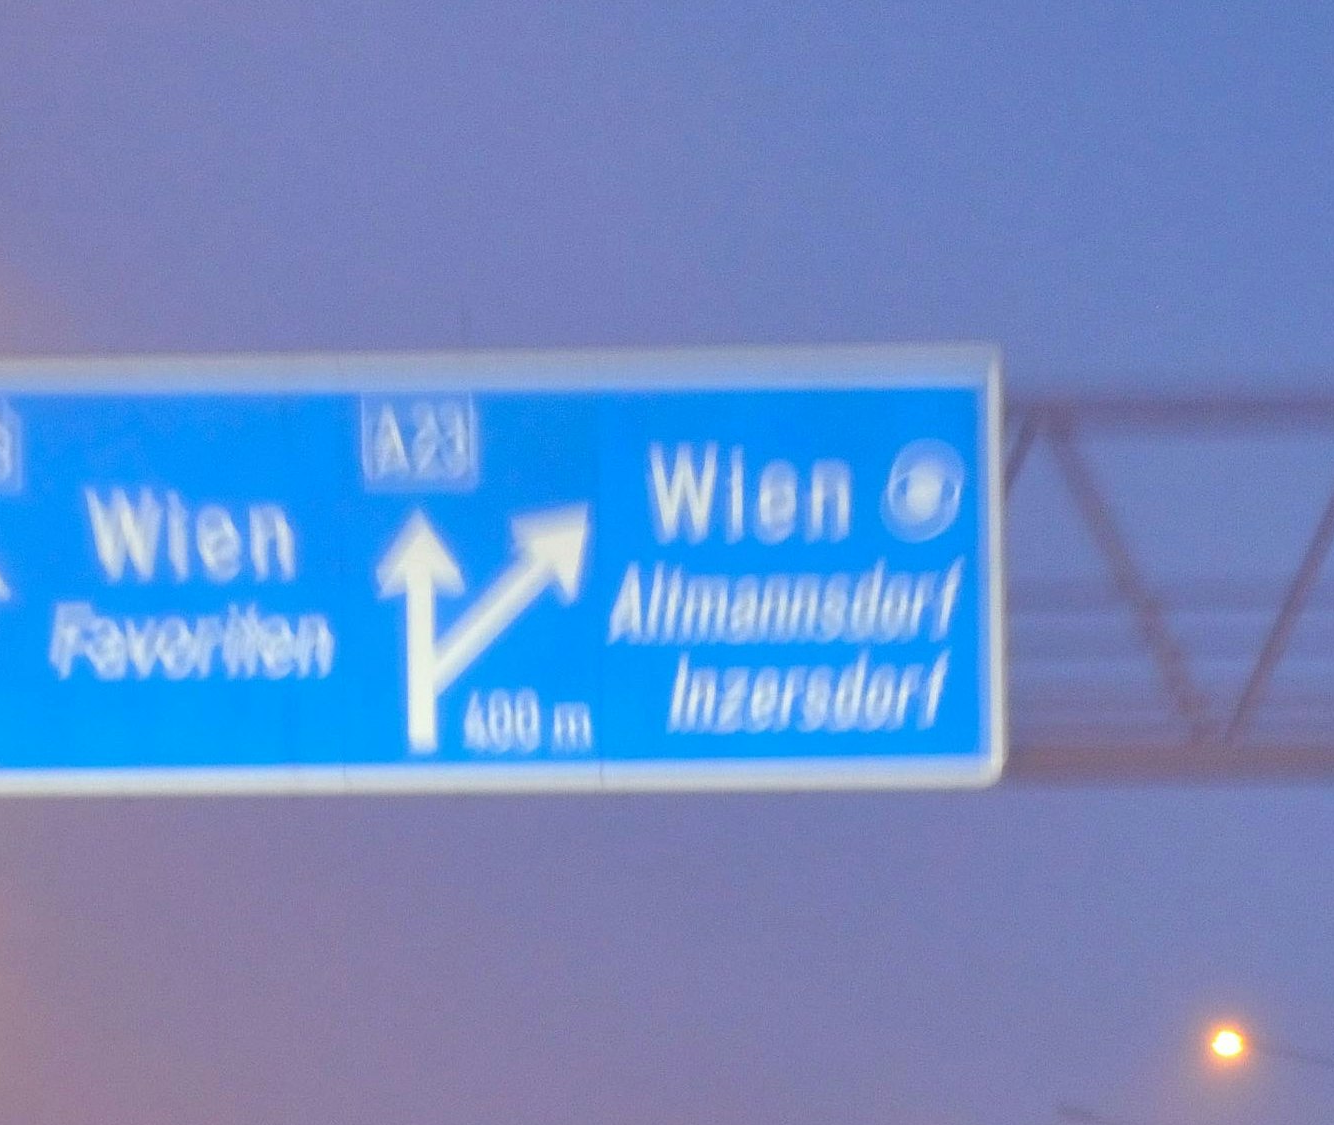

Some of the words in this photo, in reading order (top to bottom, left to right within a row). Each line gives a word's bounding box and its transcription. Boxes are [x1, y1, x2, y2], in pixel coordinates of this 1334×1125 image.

[371, 404, 469, 479] A23
[84, 487, 296, 584] Wien
[647, 441, 853, 545] Wien
[49, 601, 335, 681] Favoriten
[607, 556, 965, 646] Altmannsdorf
[463, 688, 541, 756] 400
[552, 702, 591, 755] m
[668, 649, 951, 734] Inzersdorf
